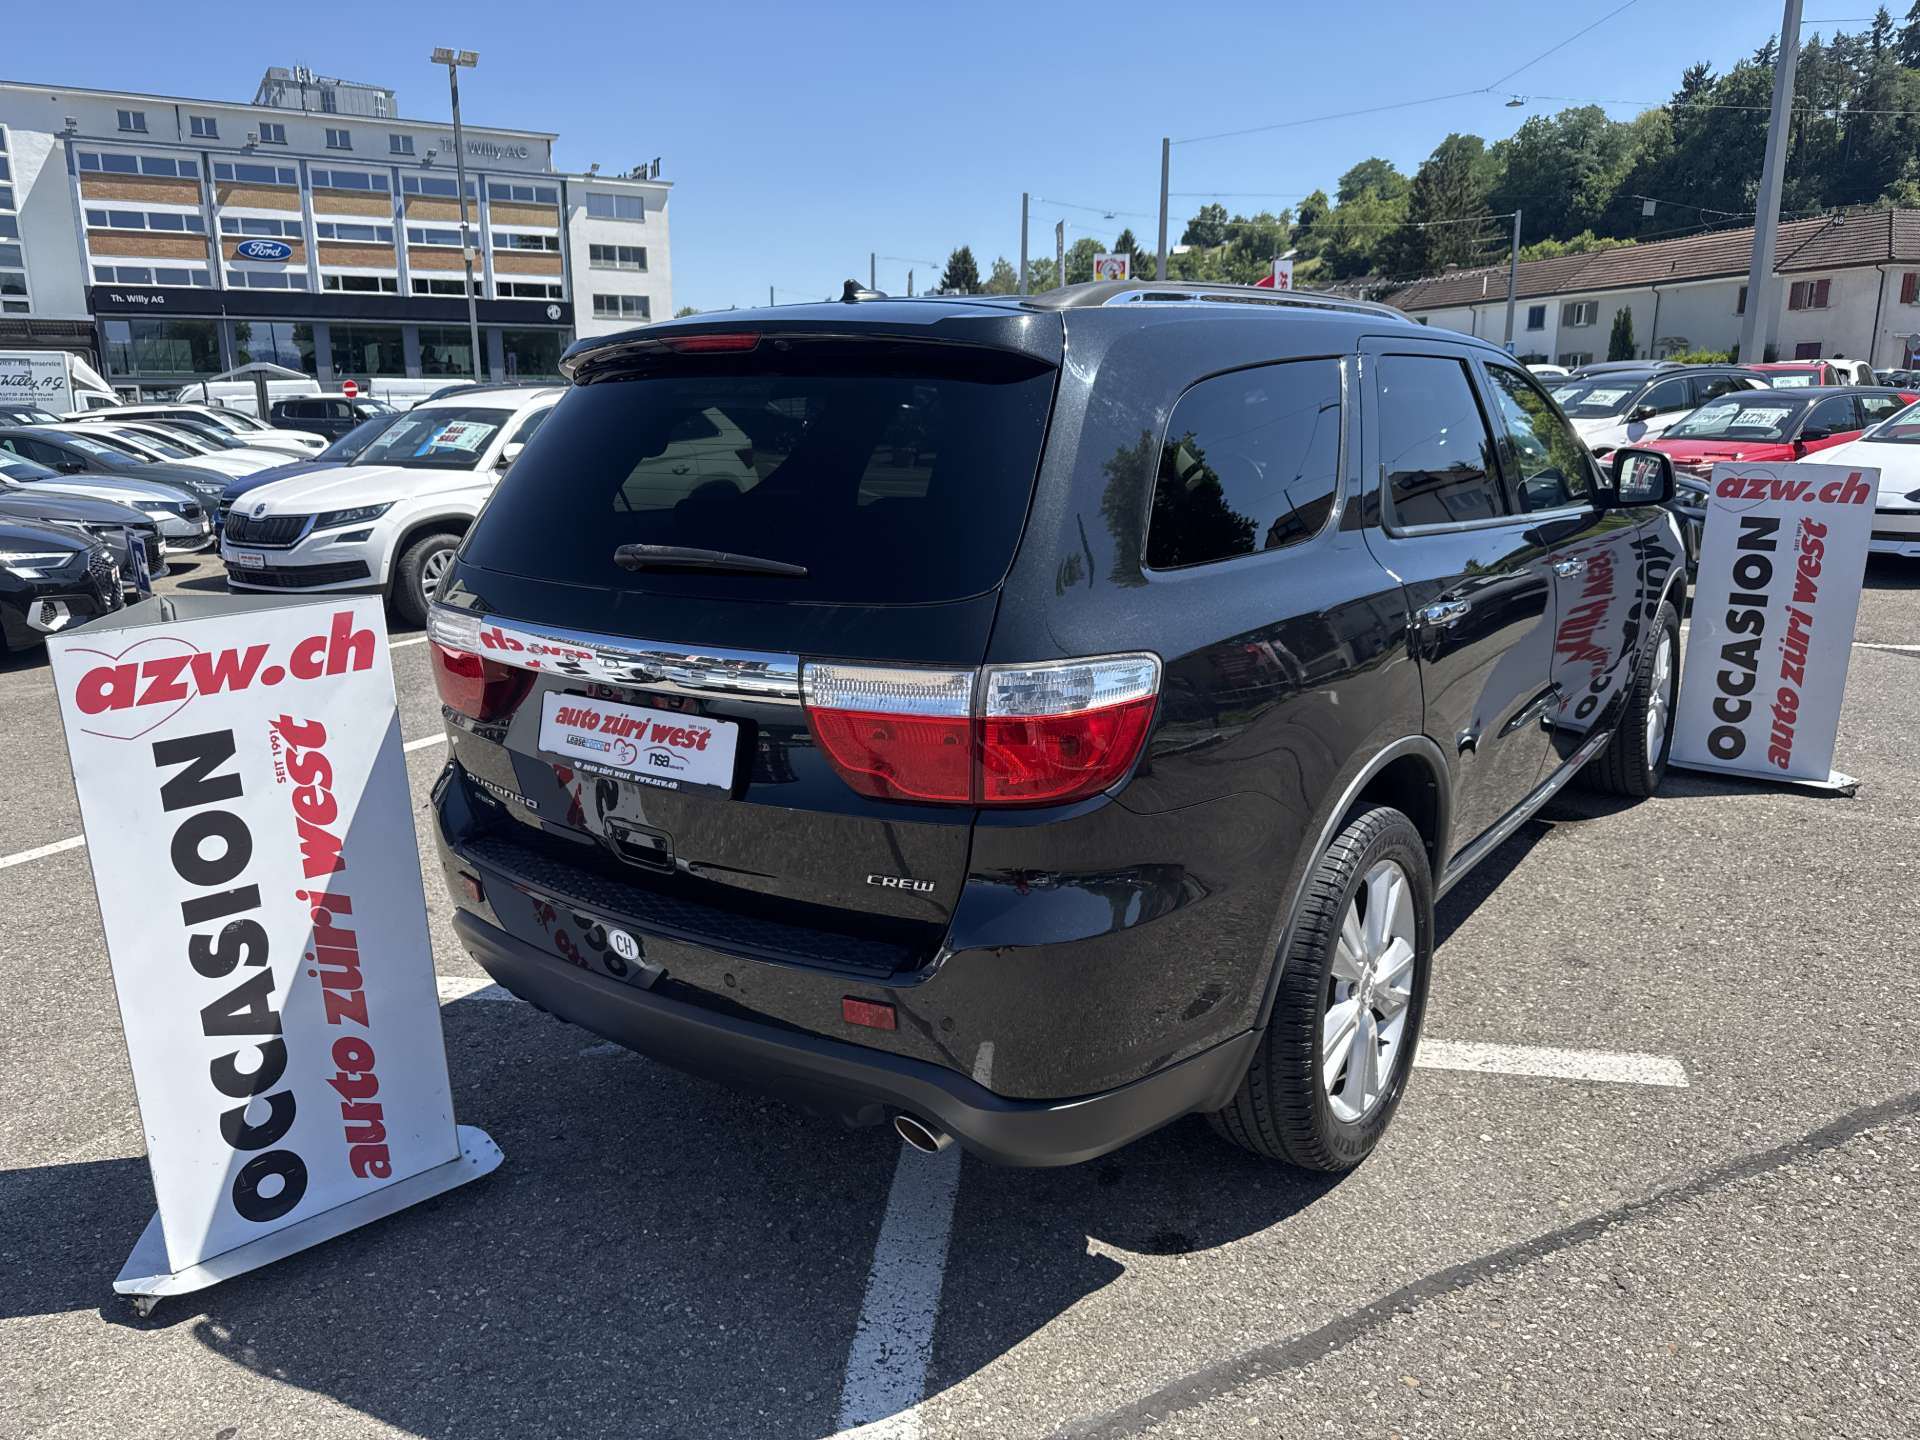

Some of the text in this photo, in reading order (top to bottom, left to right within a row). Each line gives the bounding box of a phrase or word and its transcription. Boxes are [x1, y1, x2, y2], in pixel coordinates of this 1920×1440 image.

[467, 140, 502, 160] Willy
[505, 143, 529, 160] AG
[248, 242, 282, 257] Ford
[110, 293, 165, 305] Th. Willy AG
[0, 374, 65, 391] Willy AG
[1716, 473, 1871, 505] azw.ch
[1707, 516, 1781, 761] OCCASION
[1767, 516, 1829, 770] auto züri west
[76, 611, 377, 714] azw.ch
[555, 706, 712, 751] auto züri west
[269, 729, 287, 784] SEIT 1991
[649, 752, 670, 768] nsa
[466, 772, 538, 809] DURANGO
[634, 774, 678, 790] www.azw.ch
[866, 873, 935, 892] CREW
[267, 713, 393, 1180] auto züri west
[616, 934, 632, 957] CH
[153, 729, 308, 1223] OCCASION
